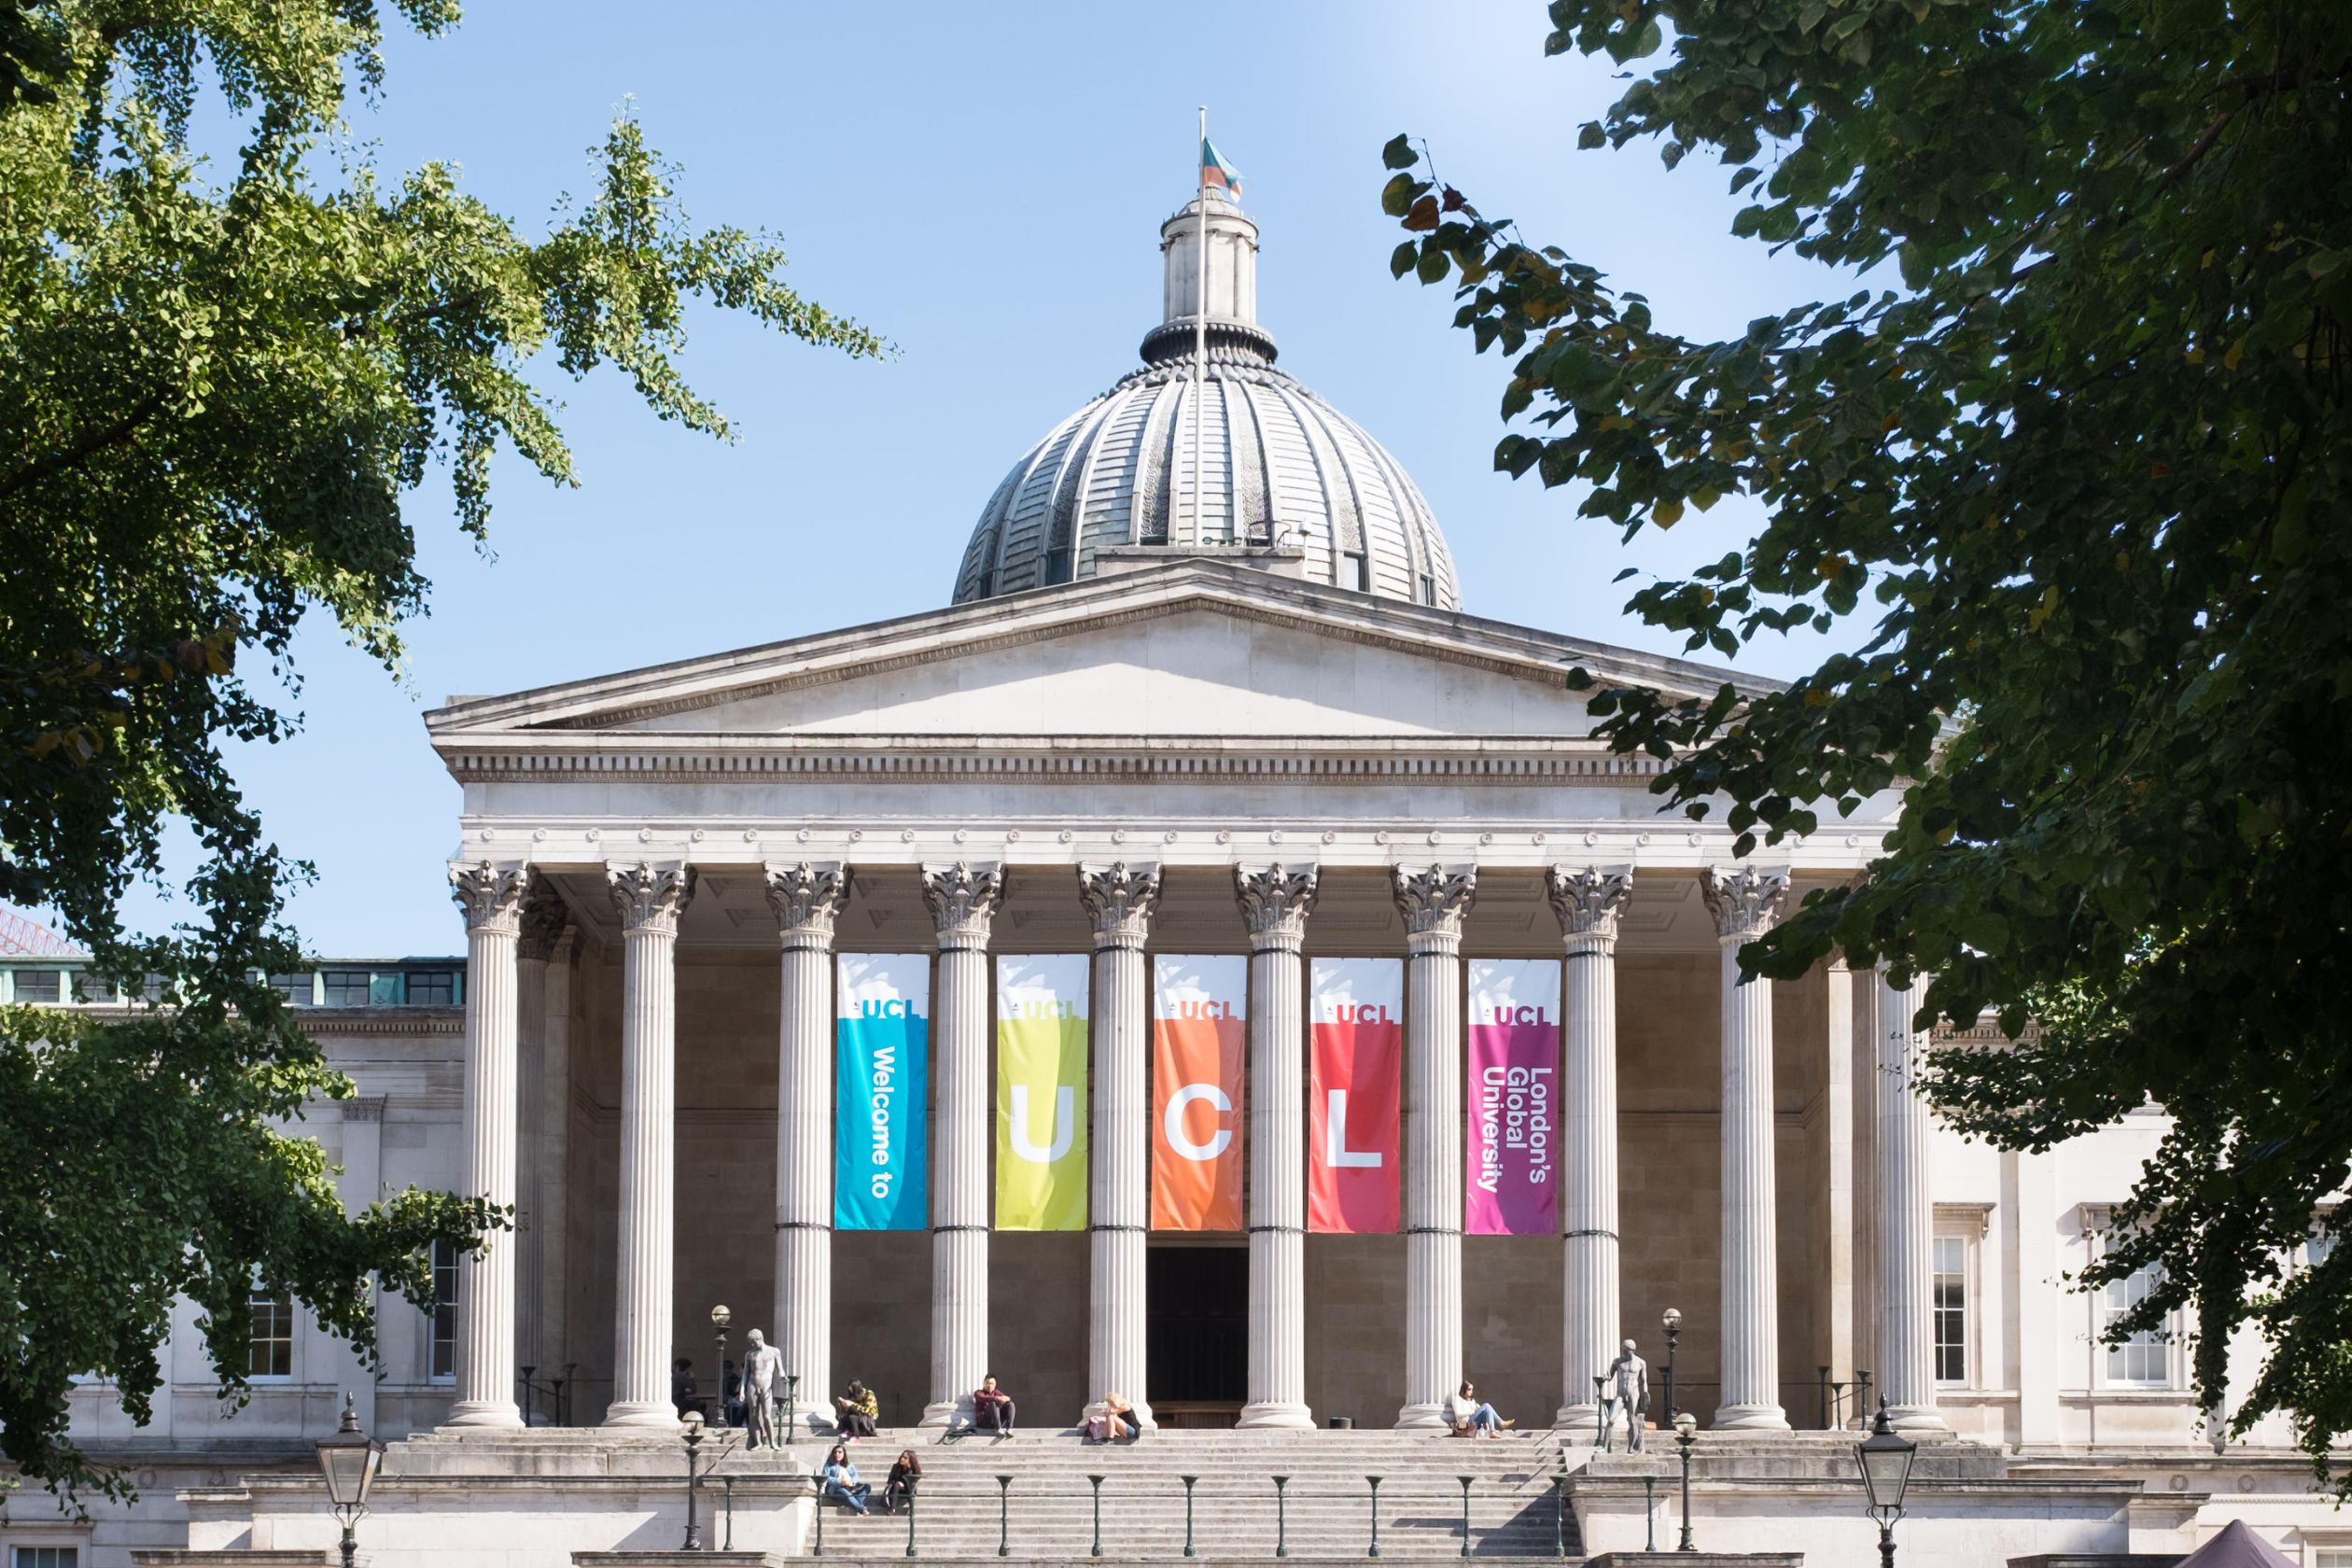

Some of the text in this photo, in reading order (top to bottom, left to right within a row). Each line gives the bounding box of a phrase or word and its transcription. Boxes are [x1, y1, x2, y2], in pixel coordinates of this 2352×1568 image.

[862, 1000, 920, 1019] UCL
[1023, 1000, 1081, 1020] UCL
[1180, 1001, 1238, 1020] UCL
[1337, 1004, 1394, 1025] UCL
[1494, 1006, 1551, 1026] UCL
[872, 1046, 895, 1198] Welcome to
[1010, 1085, 1073, 1163] U
[1164, 1083, 1233, 1160] C
[1327, 1089, 1382, 1168] L
[1477, 1066, 1505, 1194] University
[1505, 1066, 1529, 1148] Global
[1530, 1068, 1552, 1183] London's
